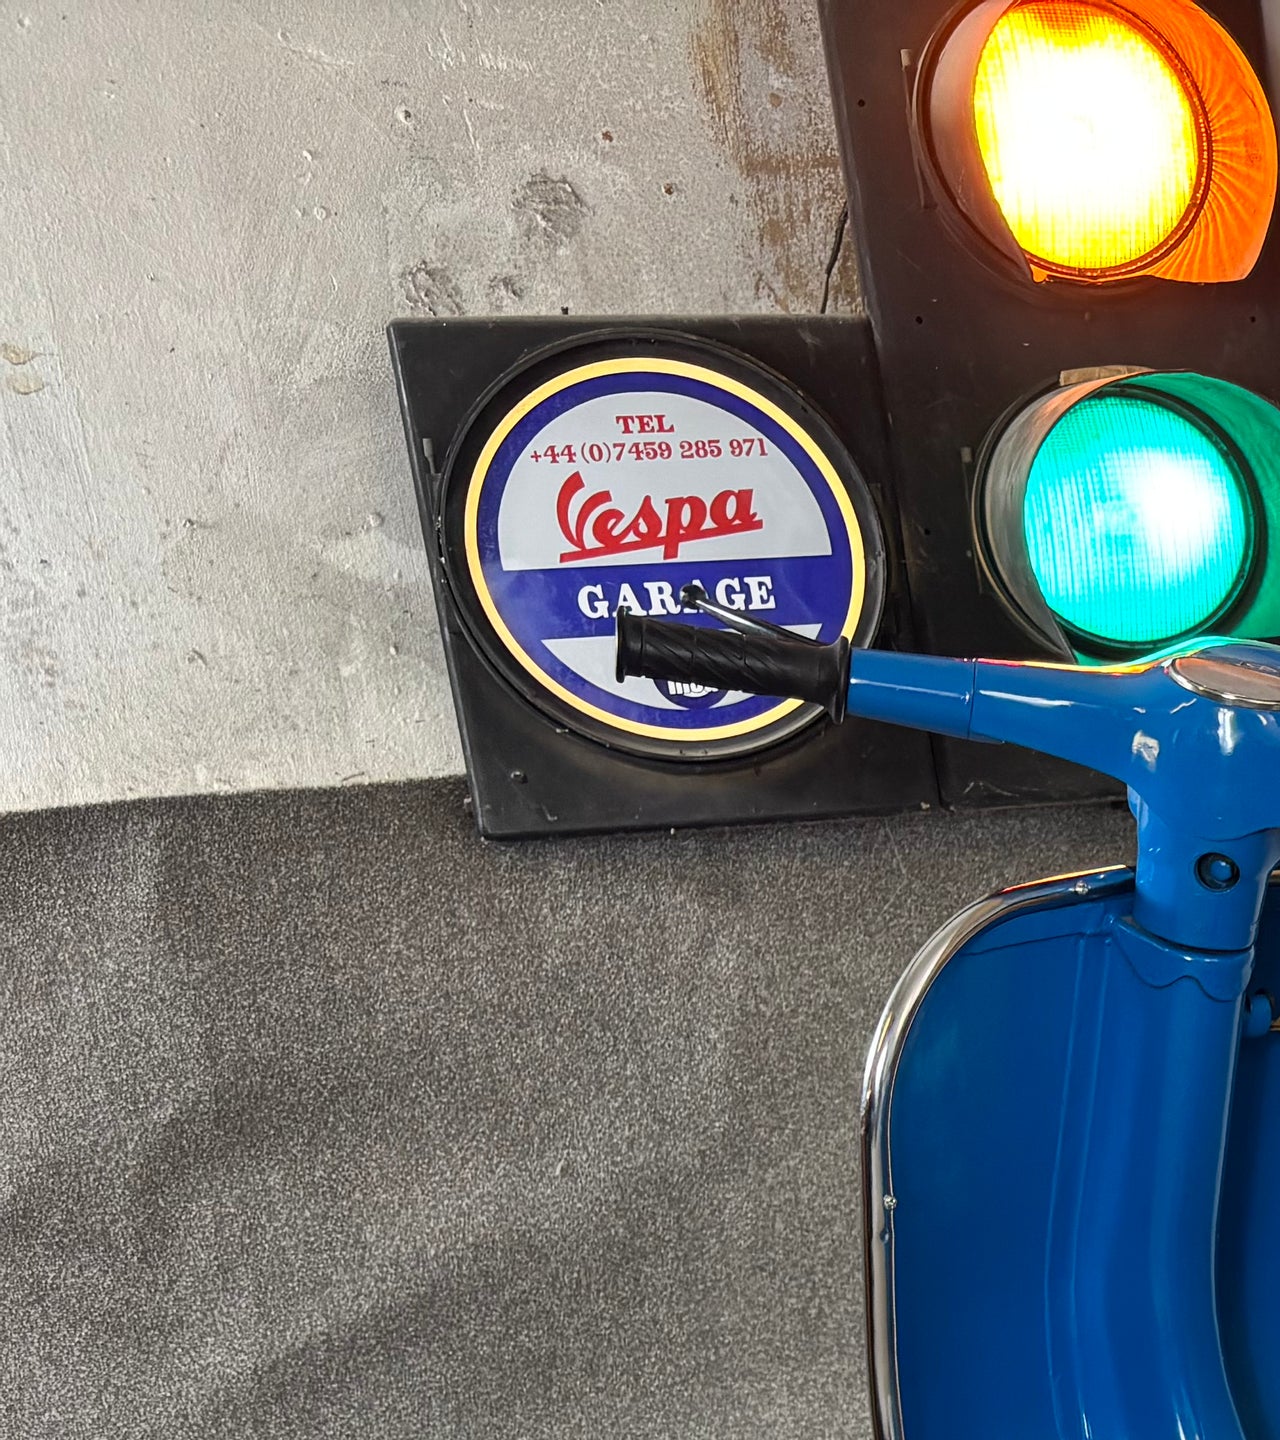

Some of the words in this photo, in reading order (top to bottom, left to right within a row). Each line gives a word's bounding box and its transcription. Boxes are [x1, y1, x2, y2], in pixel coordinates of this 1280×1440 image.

[615, 414, 675, 435] TEL
[679, 439, 723, 460] 285
[729, 437, 769, 457] 971
[556, 470, 763, 564] Vespa
